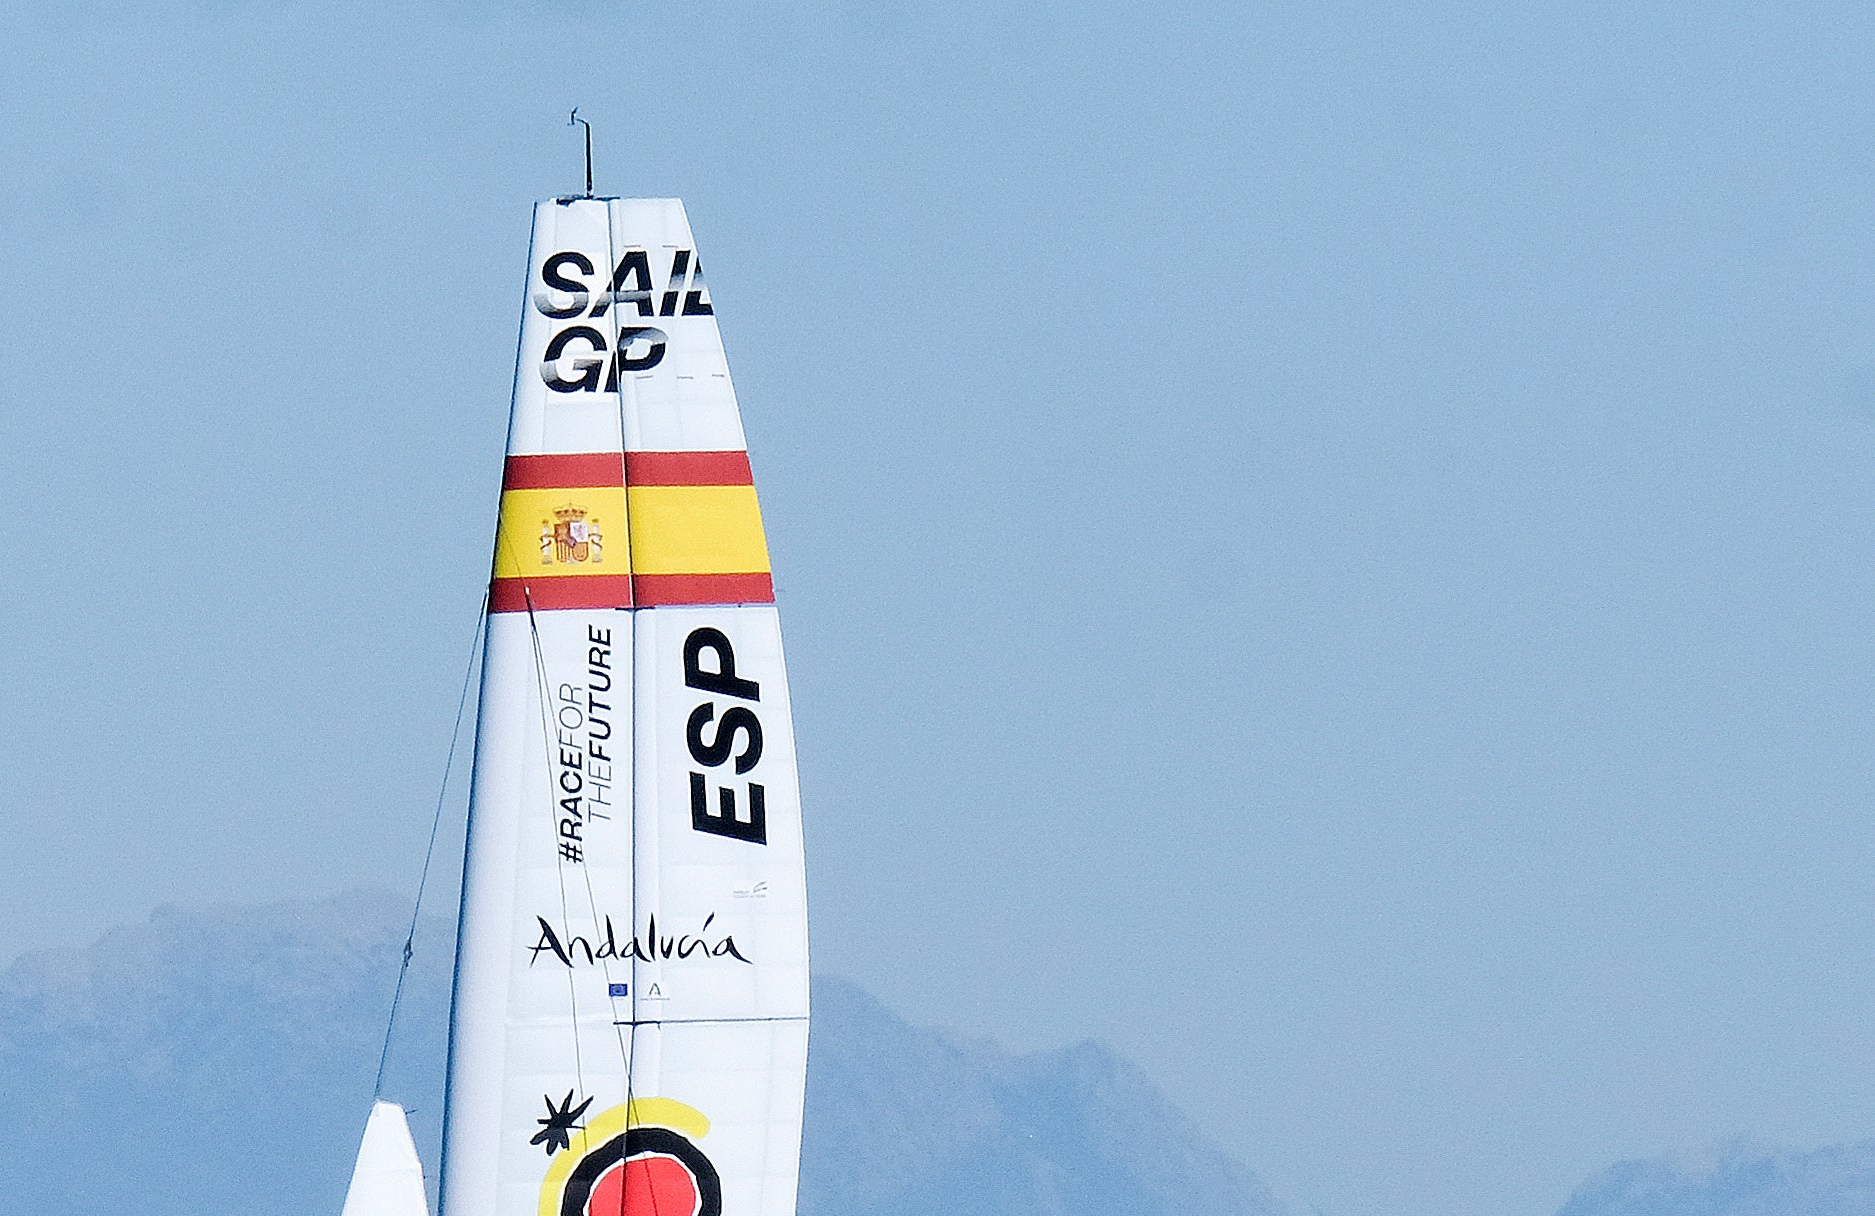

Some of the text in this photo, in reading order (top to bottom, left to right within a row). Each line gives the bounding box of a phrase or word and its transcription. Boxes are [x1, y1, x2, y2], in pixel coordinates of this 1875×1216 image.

[533, 250, 715, 319] SAIL
[539, 325, 668, 393] GP
[683, 626, 768, 846] ESP
[529, 913, 753, 967] Andalucía
